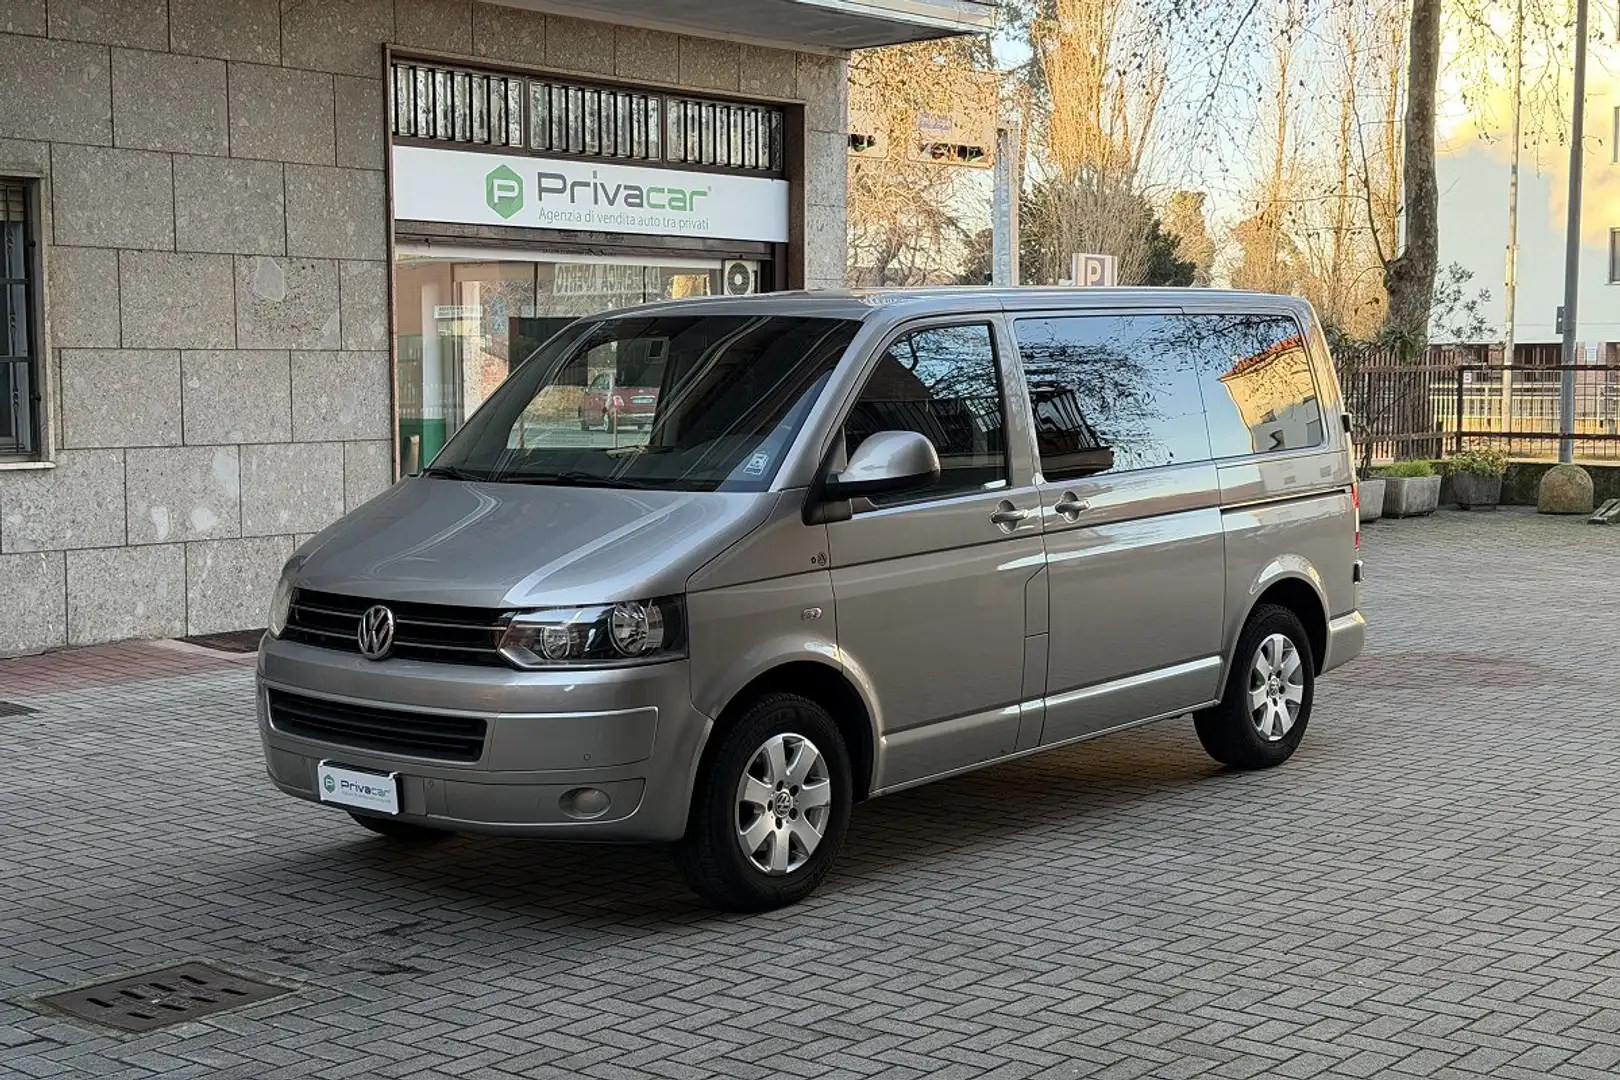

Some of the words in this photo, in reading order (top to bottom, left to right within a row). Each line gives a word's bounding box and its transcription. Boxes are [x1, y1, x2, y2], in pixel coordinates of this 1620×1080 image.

[539, 207, 582, 224] Agenzia
[585, 209, 594, 223] di
[597, 211, 635, 226] vendita
[638, 215, 661, 228] auto
[663, 217, 676, 228] tra
[679, 218, 709, 231] privati
[1086, 259, 1102, 286] P
[341, 780, 390, 798] Privacar
